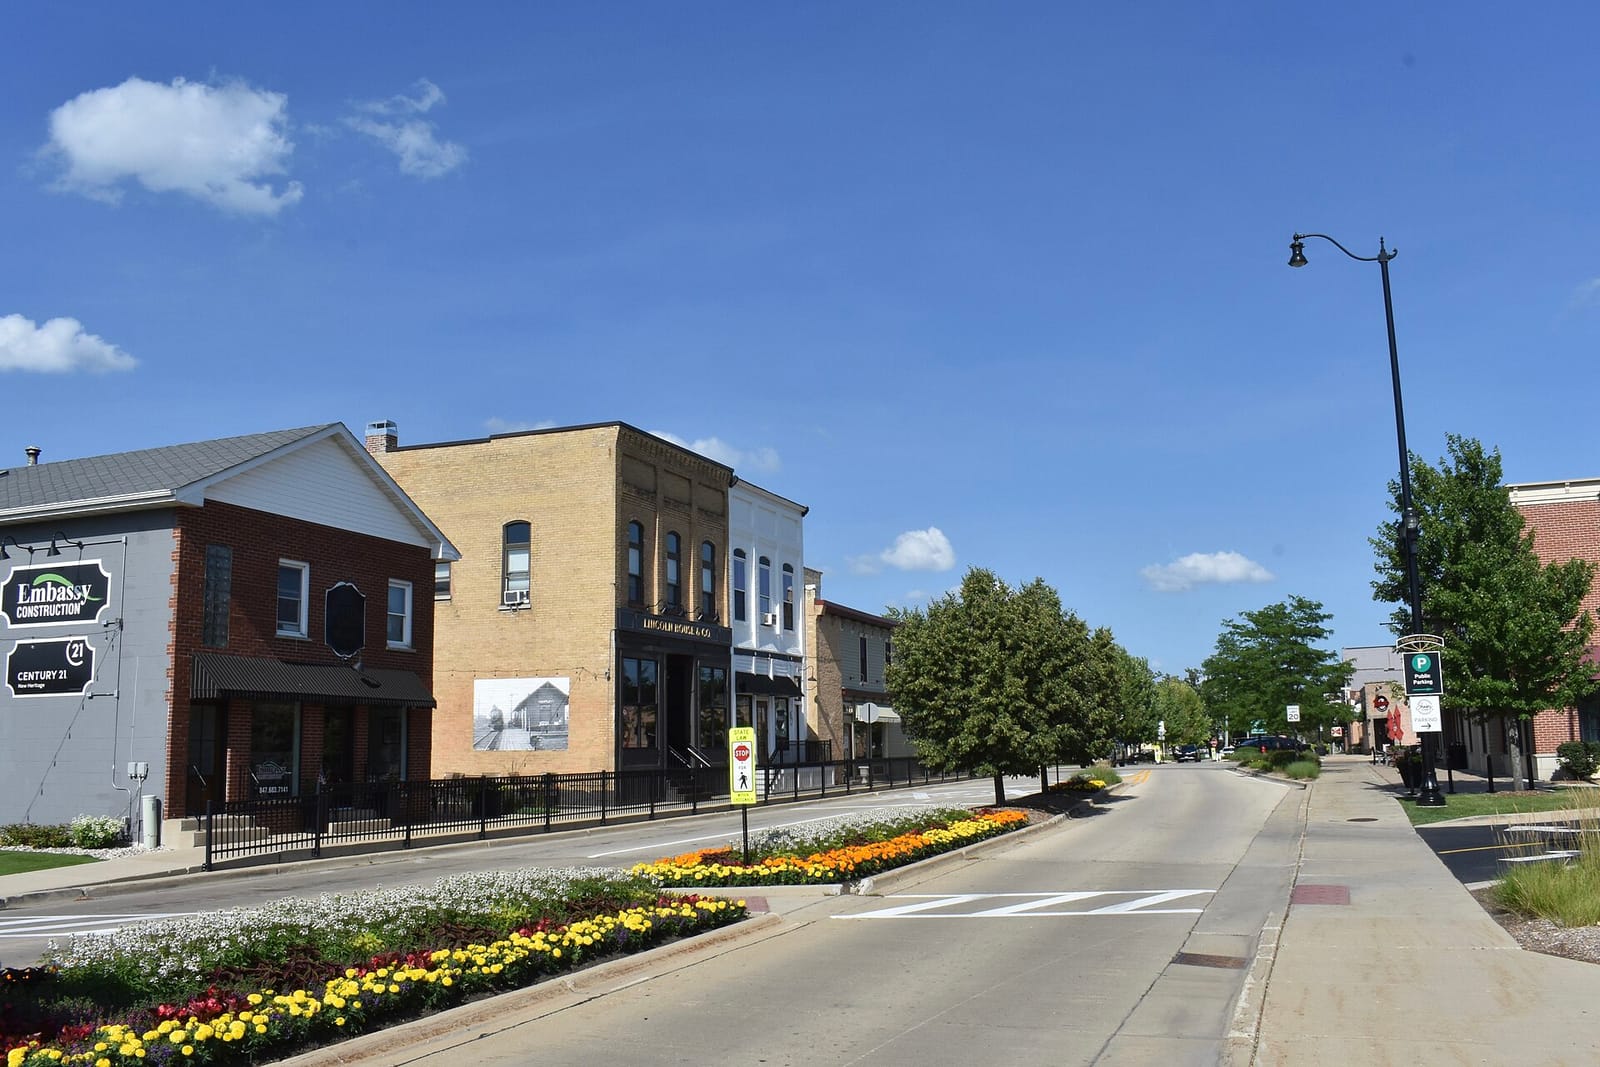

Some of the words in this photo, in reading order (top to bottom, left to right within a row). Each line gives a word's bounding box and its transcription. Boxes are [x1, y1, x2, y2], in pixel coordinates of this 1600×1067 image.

[17, 582, 92, 606] Embassy
[16, 603, 81, 618] CONSTRUCTION
[643, 618, 673, 632] LINCOLN
[674, 623, 695, 635] HOUSE
[696, 627, 701, 636] &
[1417, 657, 1427, 669] P
[17, 670, 57, 681] CENTURY
[58, 669, 67, 680] 21
